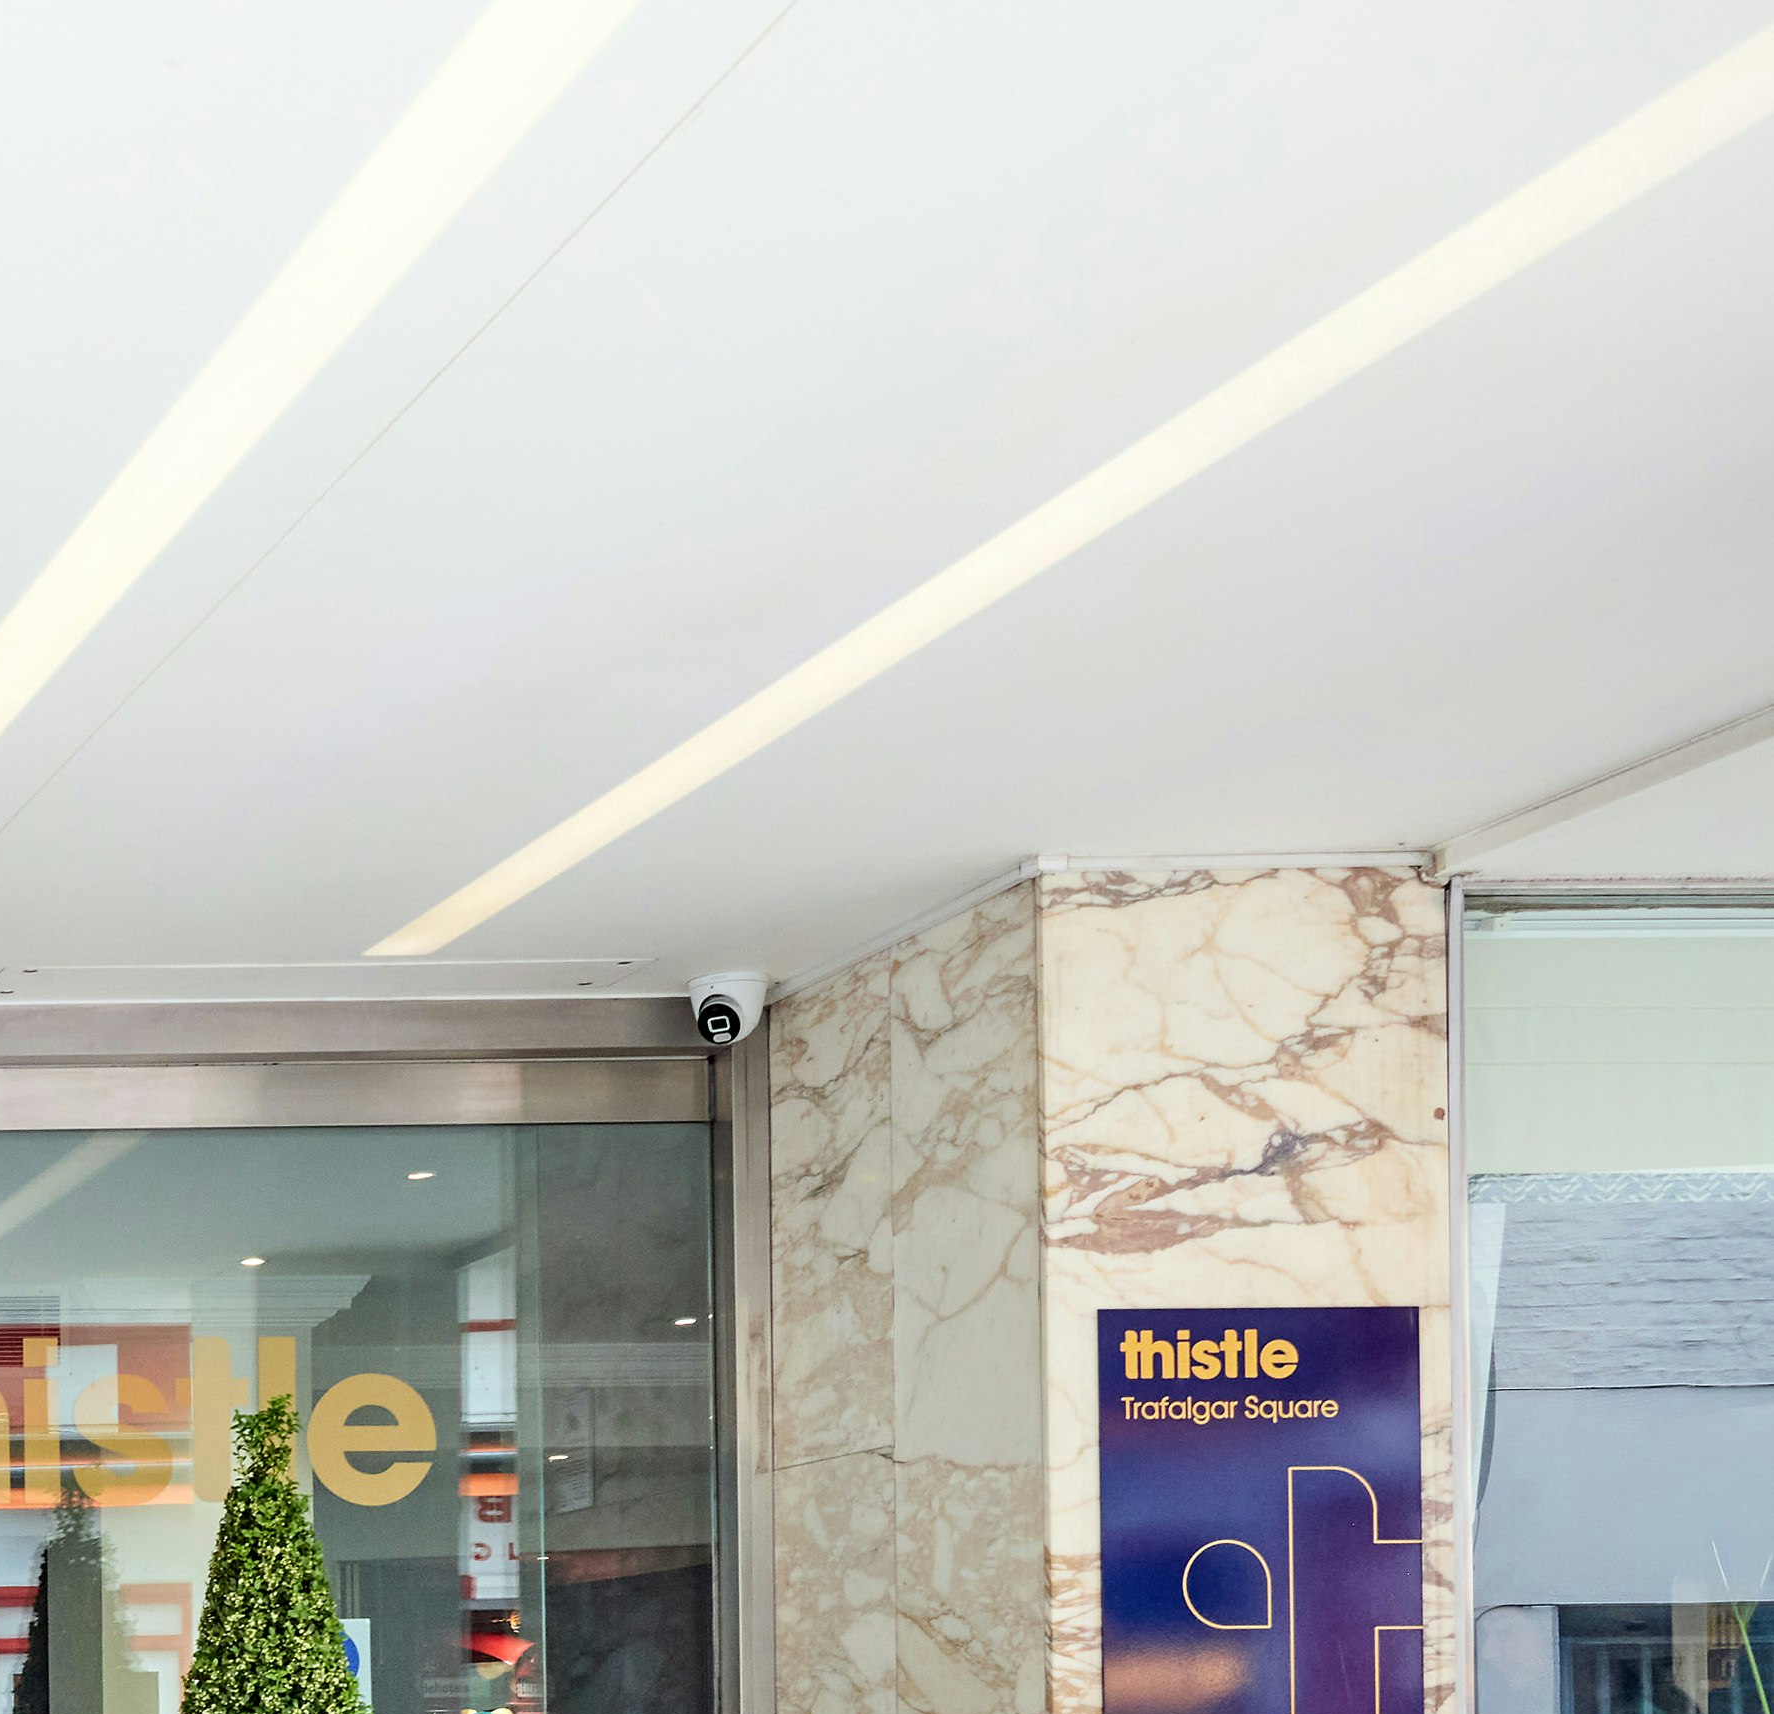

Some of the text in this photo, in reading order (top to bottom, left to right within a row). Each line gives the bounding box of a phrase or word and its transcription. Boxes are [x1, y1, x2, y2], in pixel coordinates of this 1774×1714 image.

[1120, 1328, 1299, 1380] thistle
[1121, 1394, 1339, 1425] Trafalgar Square
